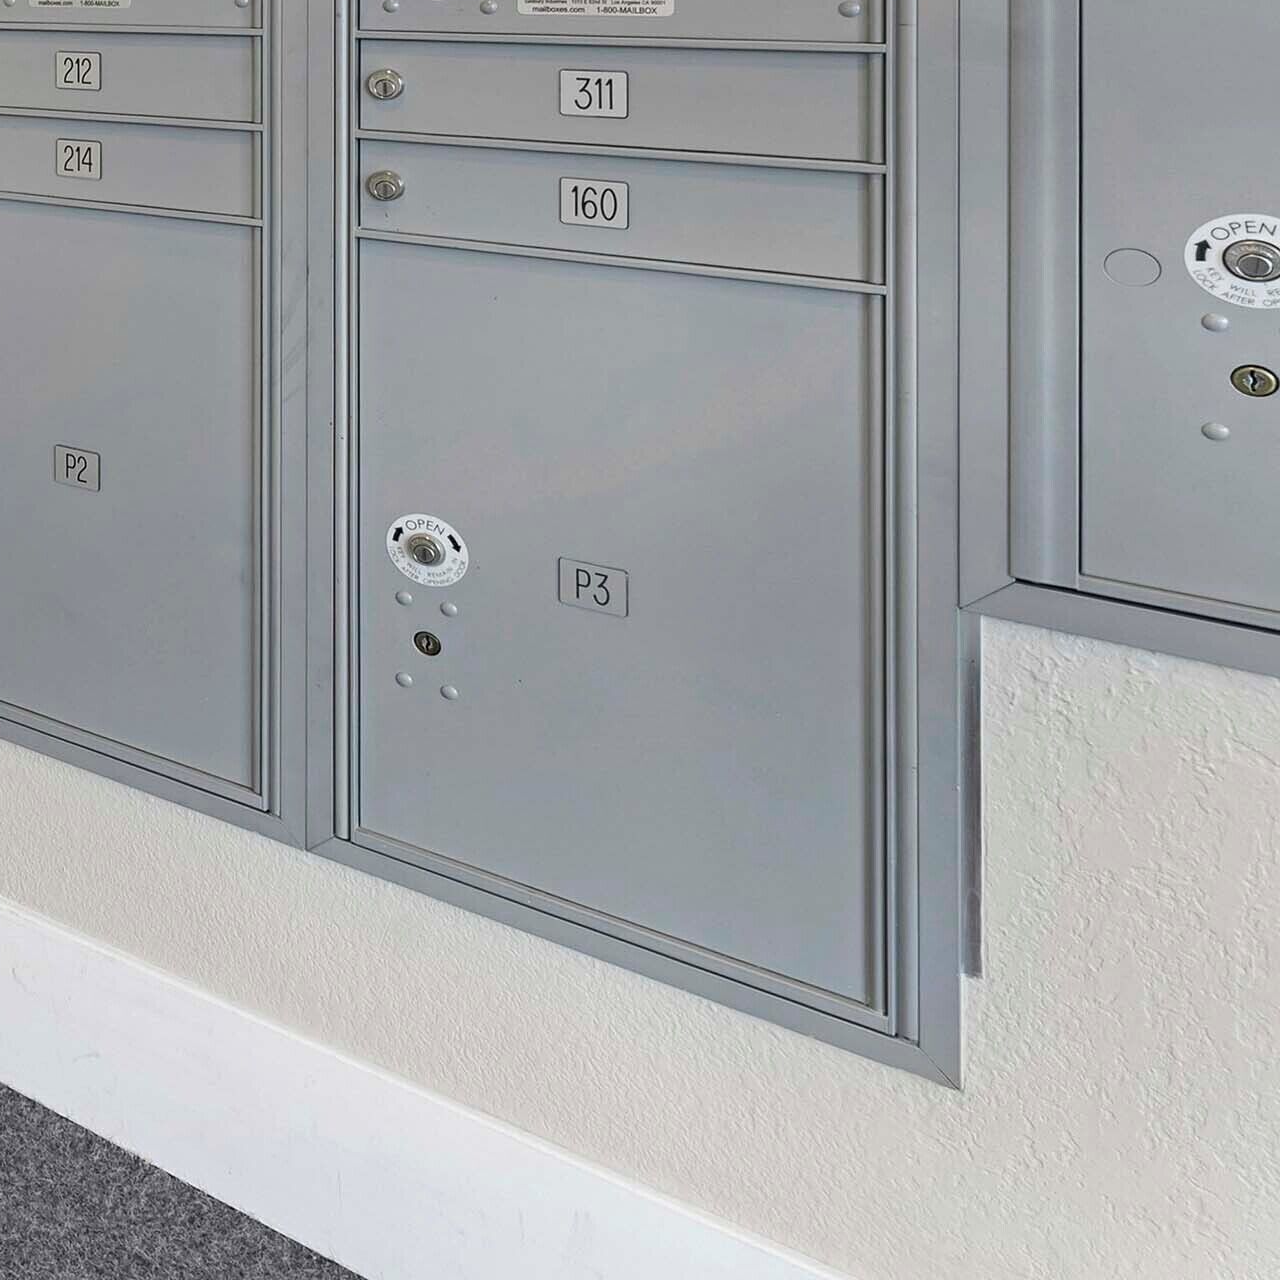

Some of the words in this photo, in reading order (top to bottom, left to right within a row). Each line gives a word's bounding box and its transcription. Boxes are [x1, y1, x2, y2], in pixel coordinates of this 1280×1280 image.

[63, 57, 92, 85] 212
[574, 77, 613, 110] 311
[63, 145, 93, 173] 214
[571, 185, 618, 221] 160
[1210, 219, 1278, 240] OPEN
[65, 453, 88, 484] P2
[405, 518, 446, 536] OPEN
[575, 568, 610, 606] P3
